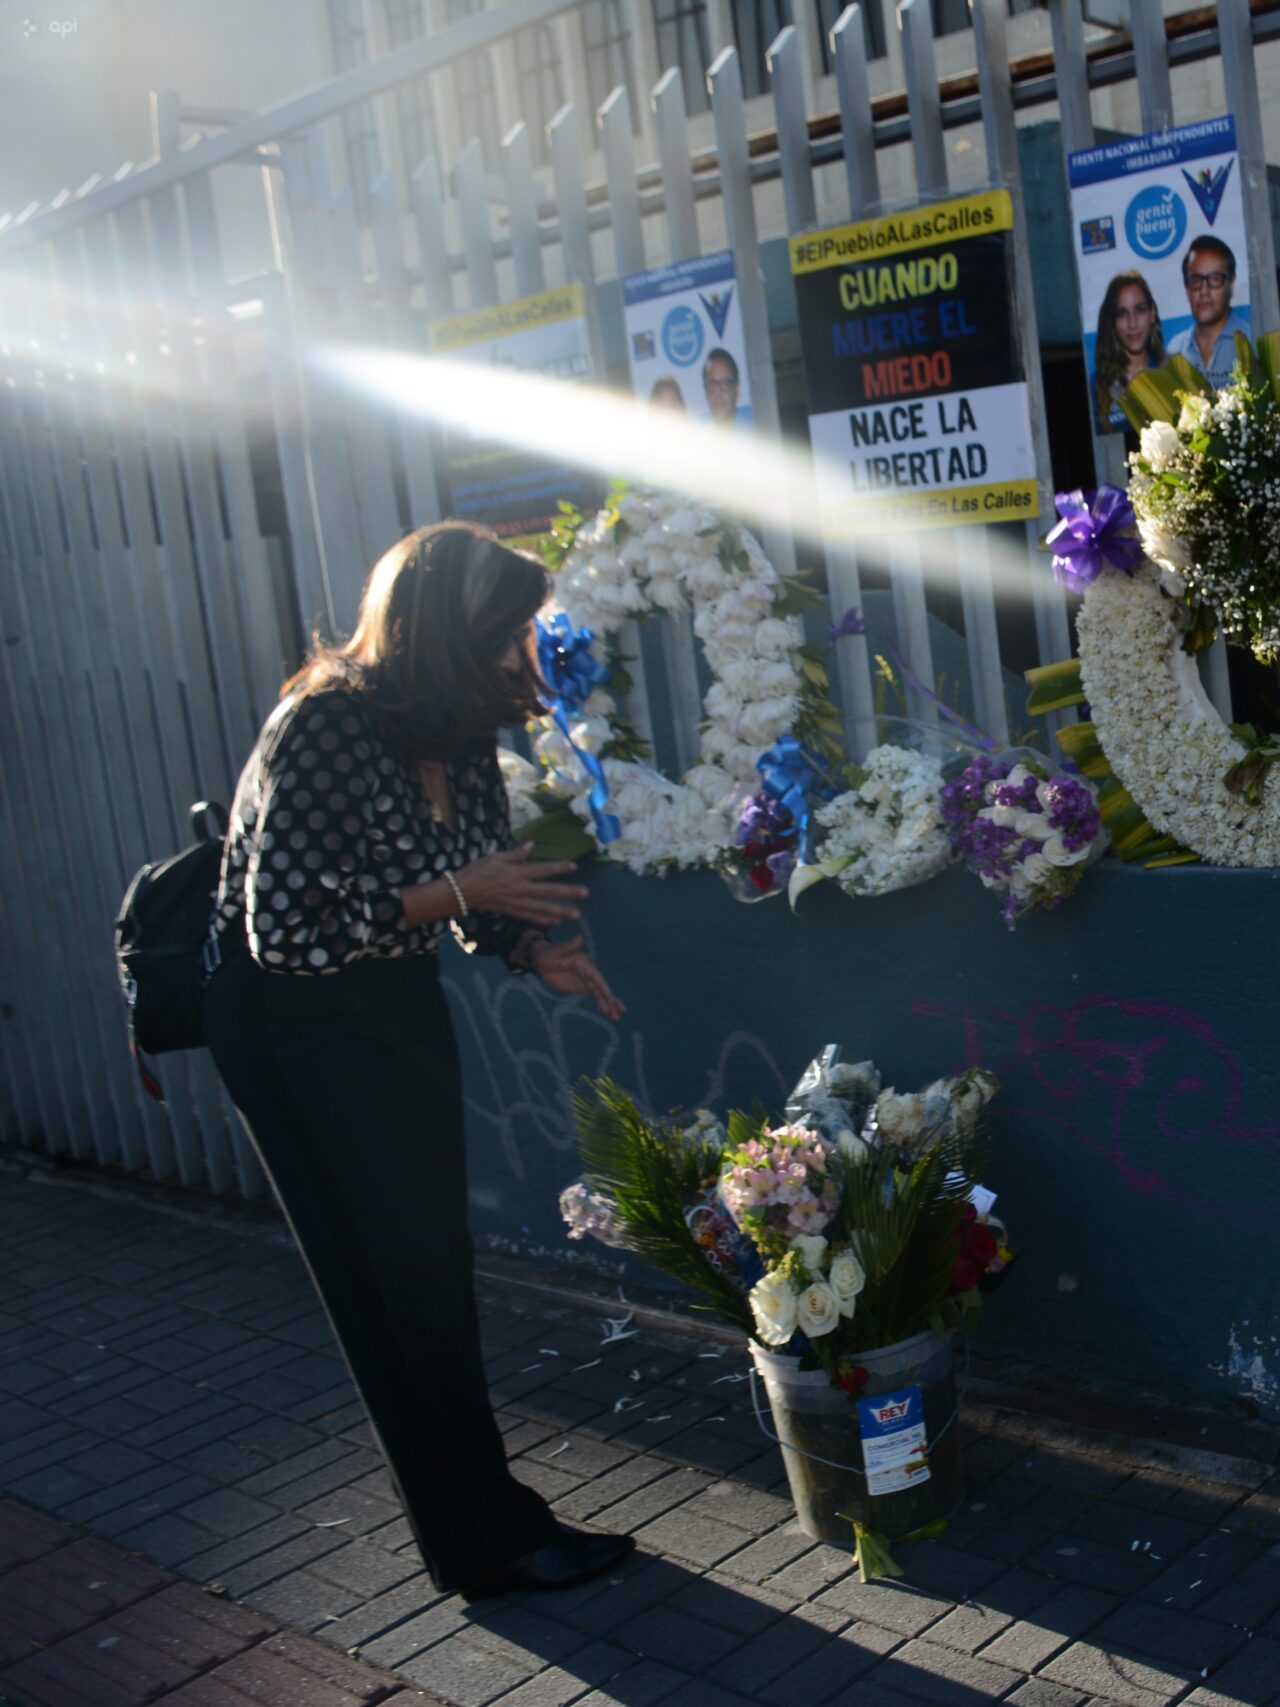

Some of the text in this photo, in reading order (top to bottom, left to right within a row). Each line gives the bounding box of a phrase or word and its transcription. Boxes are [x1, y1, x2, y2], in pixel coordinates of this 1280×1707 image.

[796, 206, 995, 267] #ElPuebloALasCalles
[838, 253, 958, 311] CUANDO
[831, 301, 976, 359] MUERE EL
[862, 351, 952, 400] MIEDO
[849, 397, 977, 448] NACE LA
[849, 443, 989, 494] LIBERTAD
[952, 498, 980, 514] Las
[984, 491, 1033, 511] Calles
[879, 1403, 907, 1421] REY
